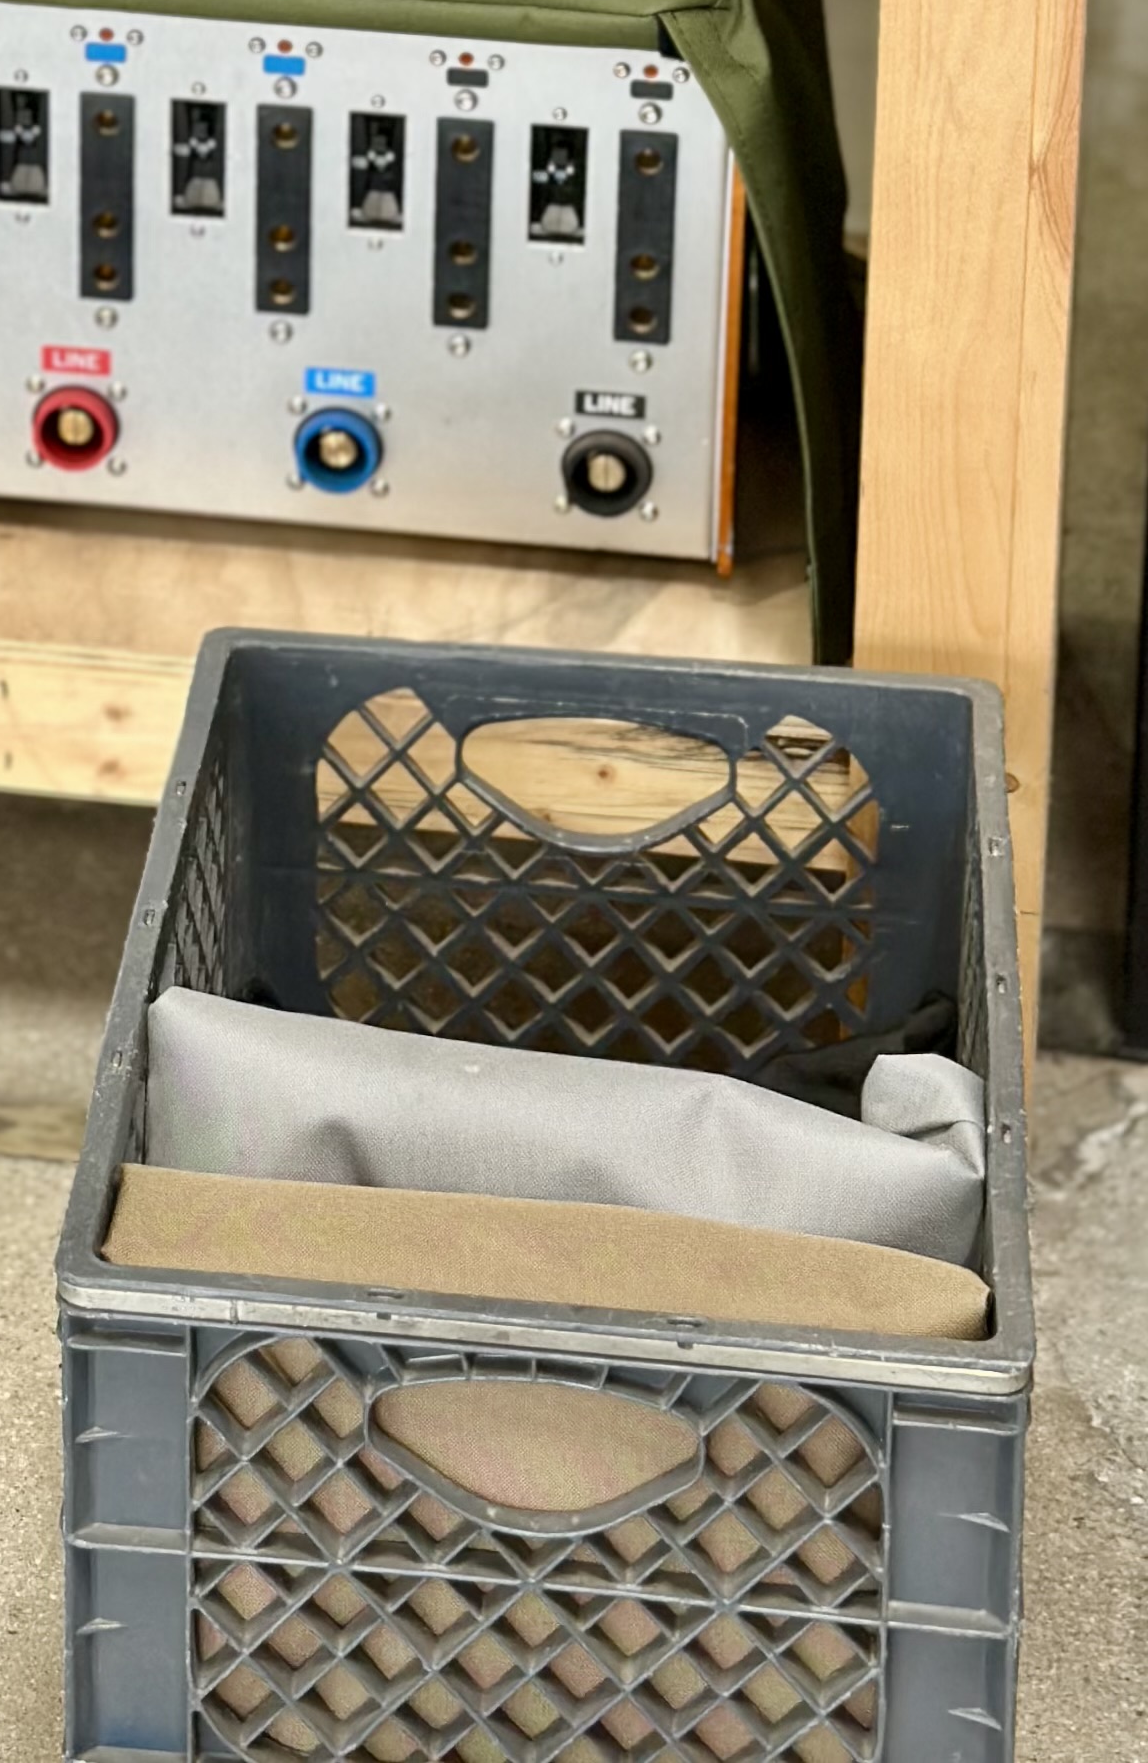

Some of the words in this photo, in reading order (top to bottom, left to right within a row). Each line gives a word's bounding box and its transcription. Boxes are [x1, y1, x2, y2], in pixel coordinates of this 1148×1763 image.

[52, 350, 101, 371] LINE
[315, 371, 364, 392] LINE
[584, 394, 636, 415] LINE
